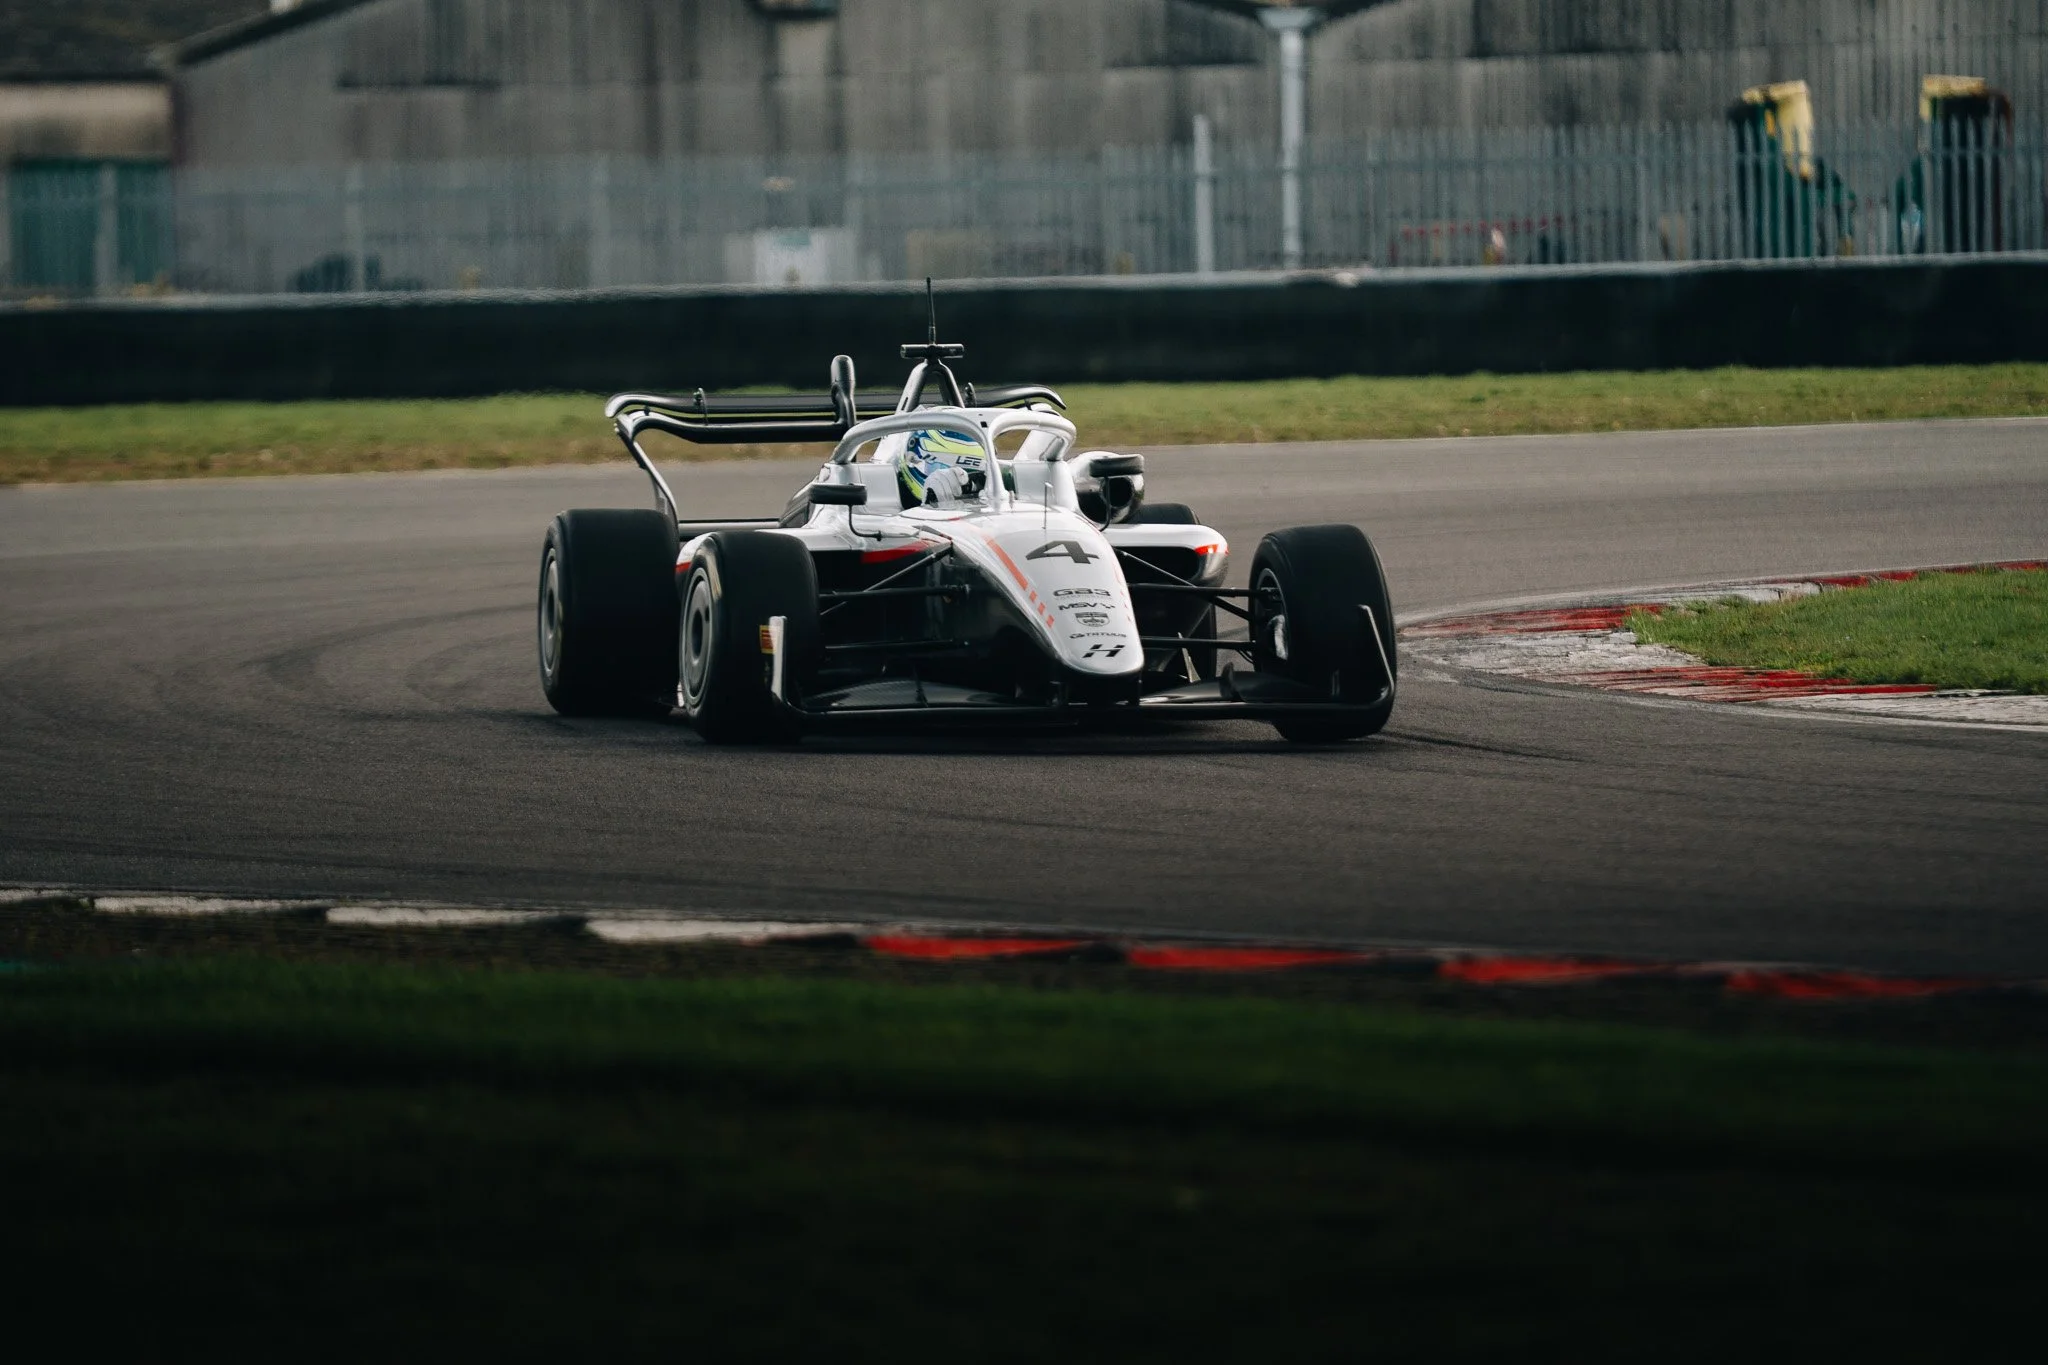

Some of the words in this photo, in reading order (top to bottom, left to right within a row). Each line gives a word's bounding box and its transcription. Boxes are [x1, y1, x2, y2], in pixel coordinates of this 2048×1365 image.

[956, 455, 982, 467] LEE
[1025, 540, 1100, 564] 4
[1058, 602, 1098, 611] MSV
